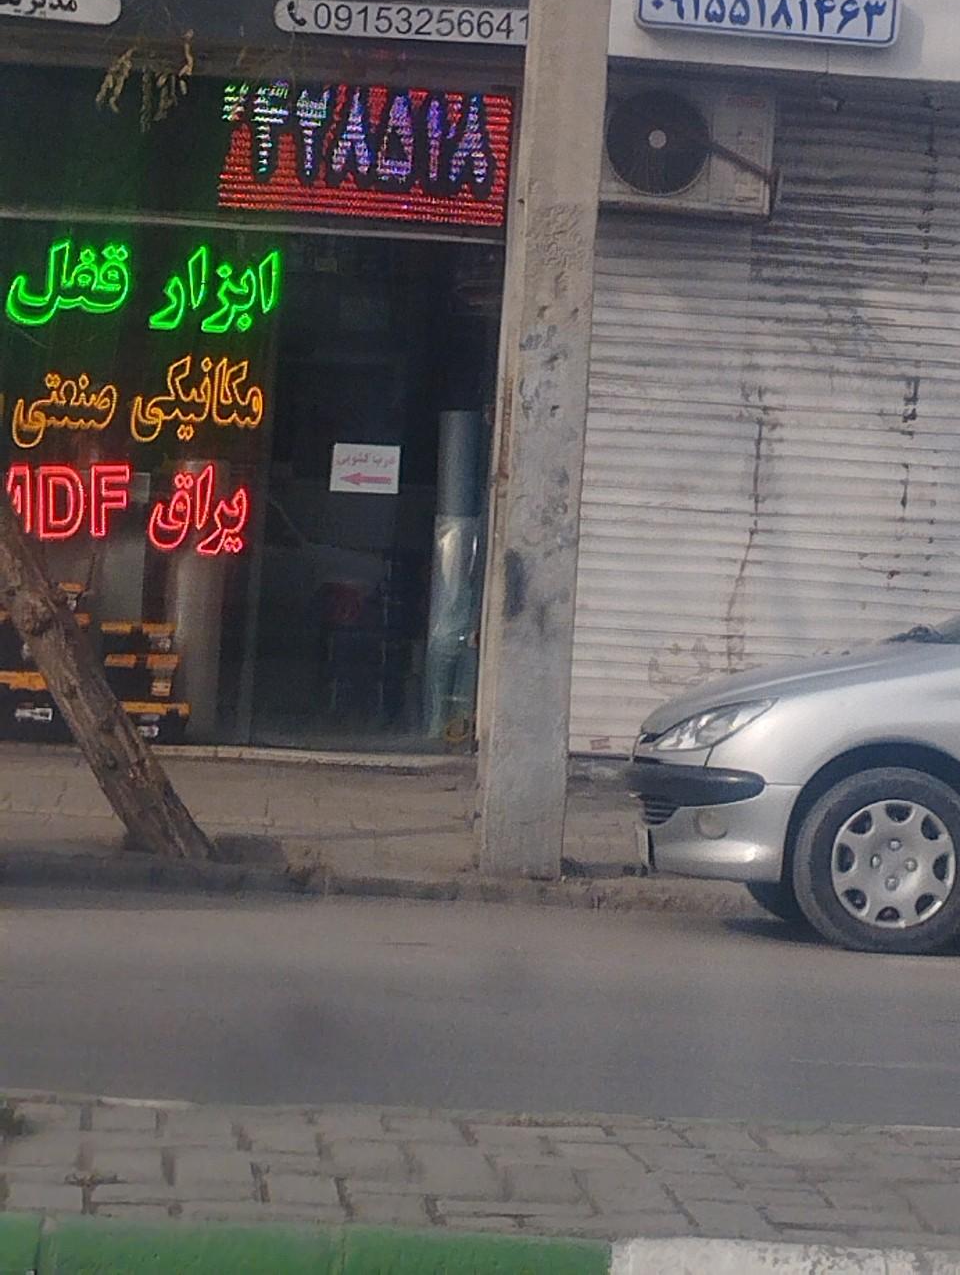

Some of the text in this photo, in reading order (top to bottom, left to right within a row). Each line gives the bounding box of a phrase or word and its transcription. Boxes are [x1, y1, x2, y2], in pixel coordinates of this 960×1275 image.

[6, 240, 279, 333] ابزار قفل
[12, 354, 264, 449] مکانیکی صنعتی
[149, 463, 249, 556] یراق
